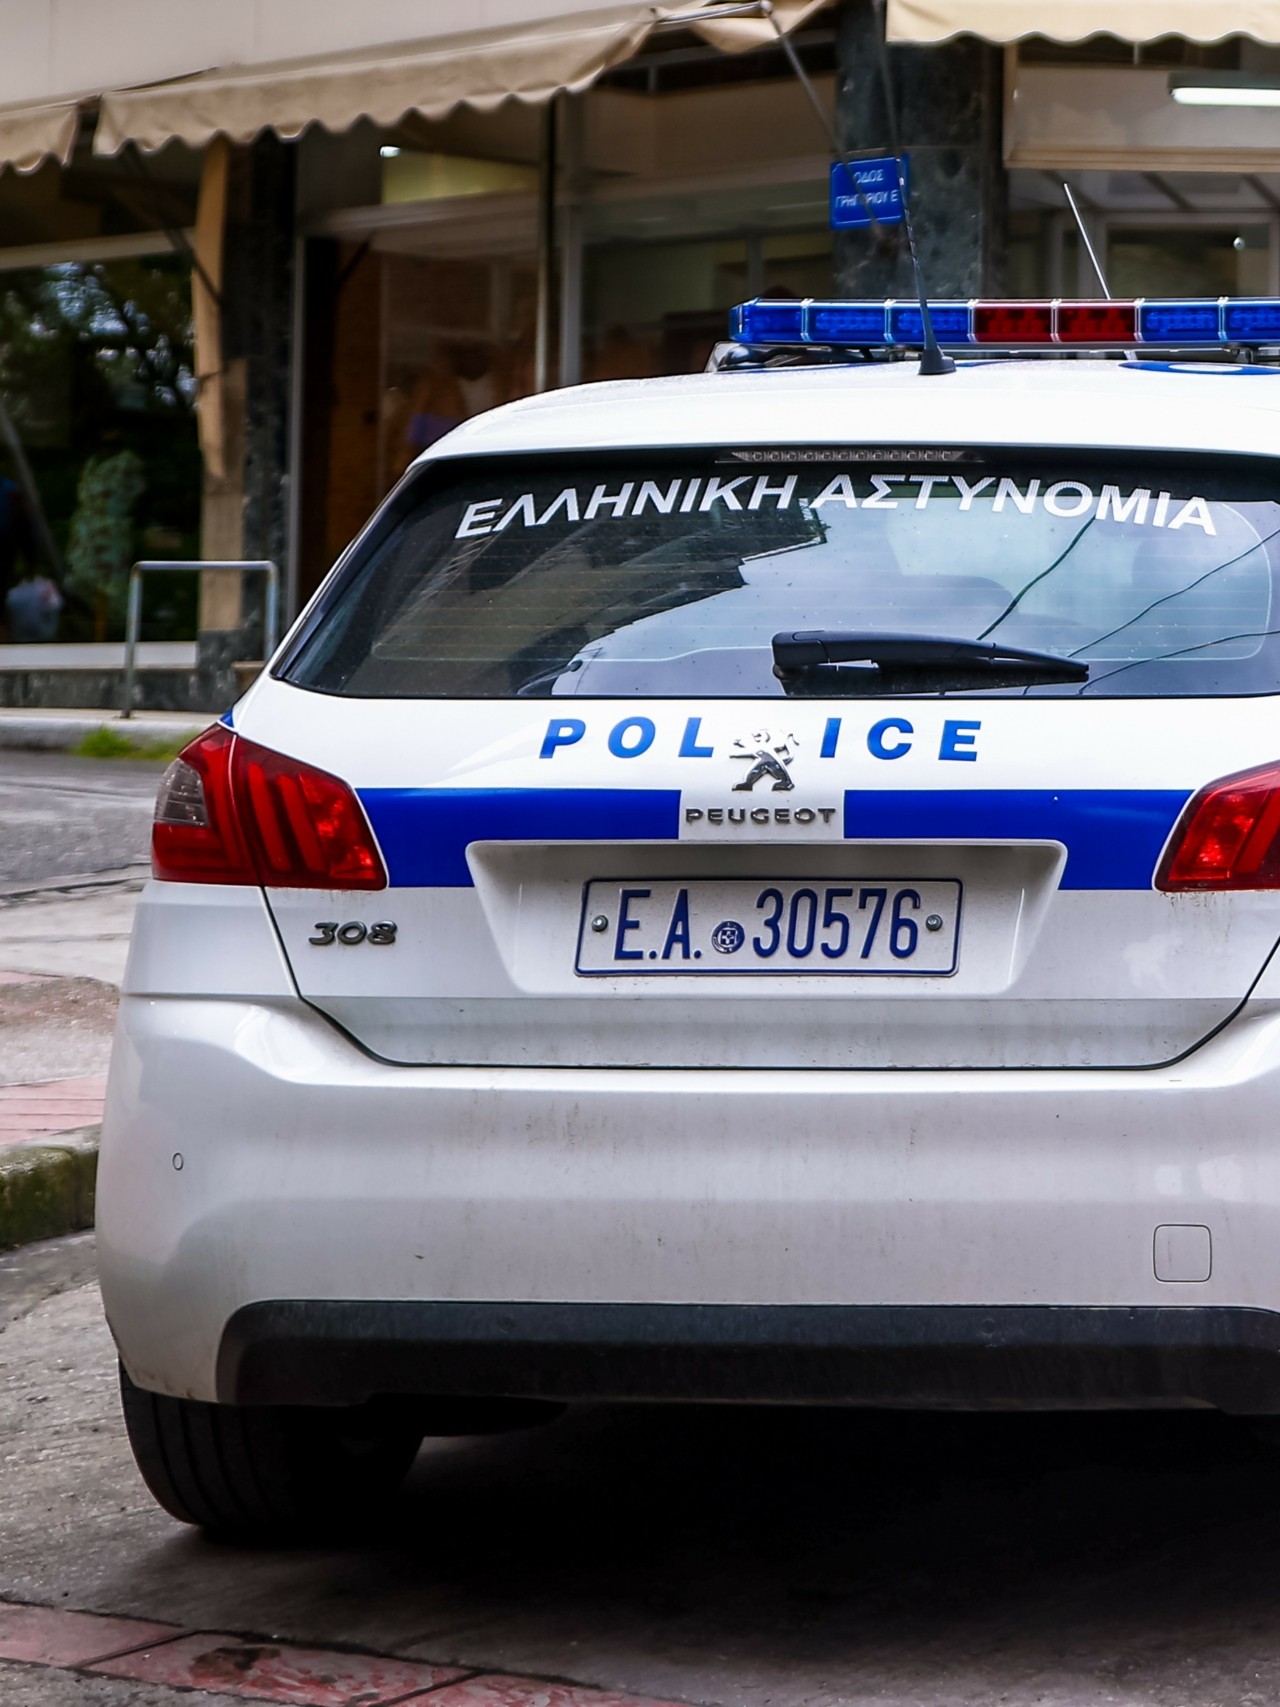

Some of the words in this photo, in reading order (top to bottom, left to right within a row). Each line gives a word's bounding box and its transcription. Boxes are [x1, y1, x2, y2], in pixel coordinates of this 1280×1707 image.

[835, 191, 888, 208] ΓΡΗΓΡΙΟΥ
[455, 474, 796, 538] ΕΛΛΗΝΙΚΗ
[808, 473, 1218, 536] ΑΣΤΥΝΟΜΙΑ
[685, 807, 836, 825] PEUGEOT
[308, 920, 398, 946] 308
[752, 888, 921, 960] 30576
